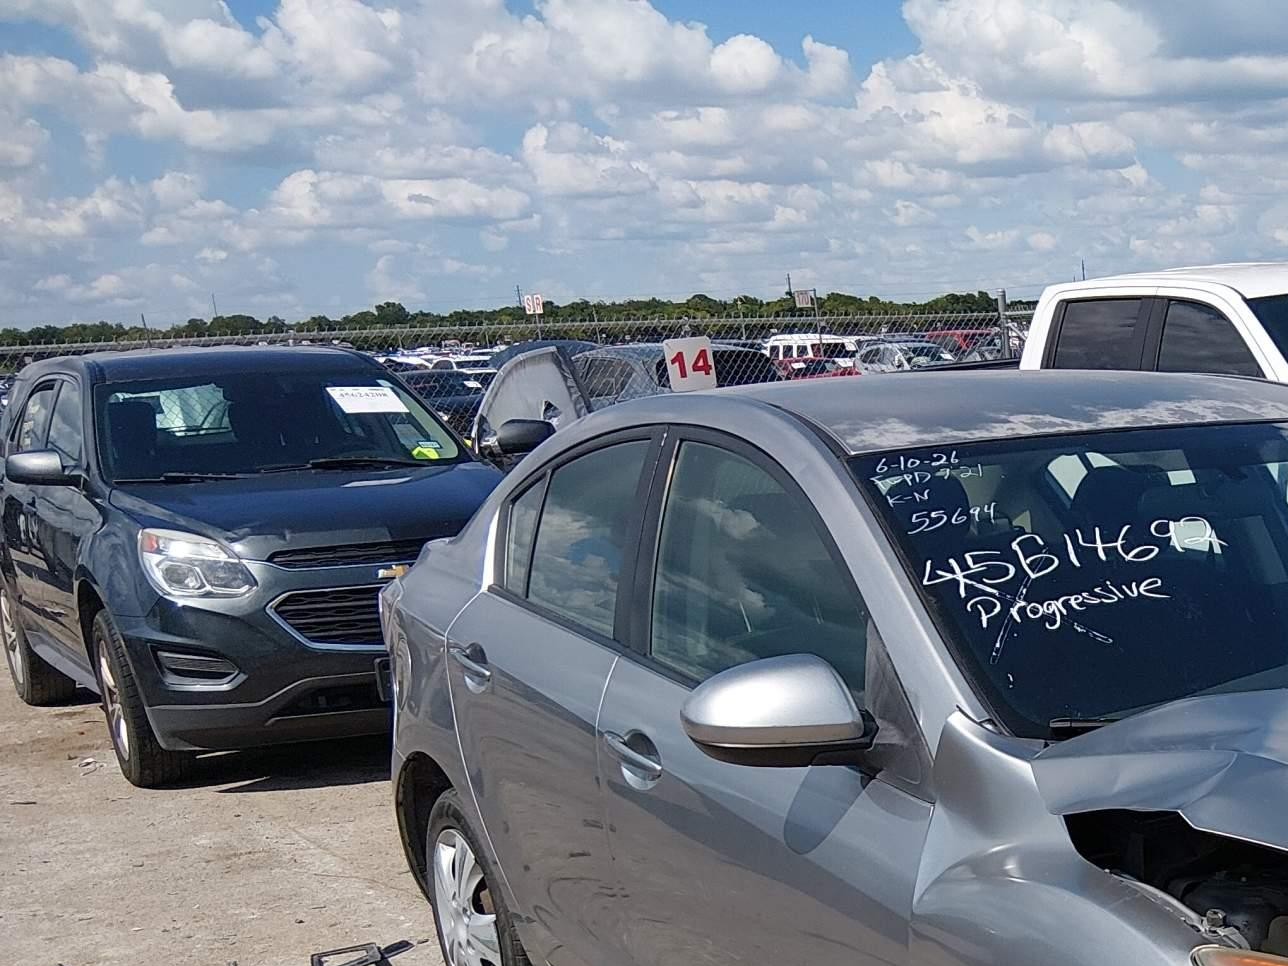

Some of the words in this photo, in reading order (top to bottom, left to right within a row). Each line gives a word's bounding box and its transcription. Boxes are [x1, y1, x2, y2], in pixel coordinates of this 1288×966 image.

[670, 348, 713, 379] 14
[875, 450, 960, 473] 6-10-26
[906, 502, 998, 535] 55694
[922, 516, 1230, 598] 45614692
[966, 577, 1172, 629] Progressive
